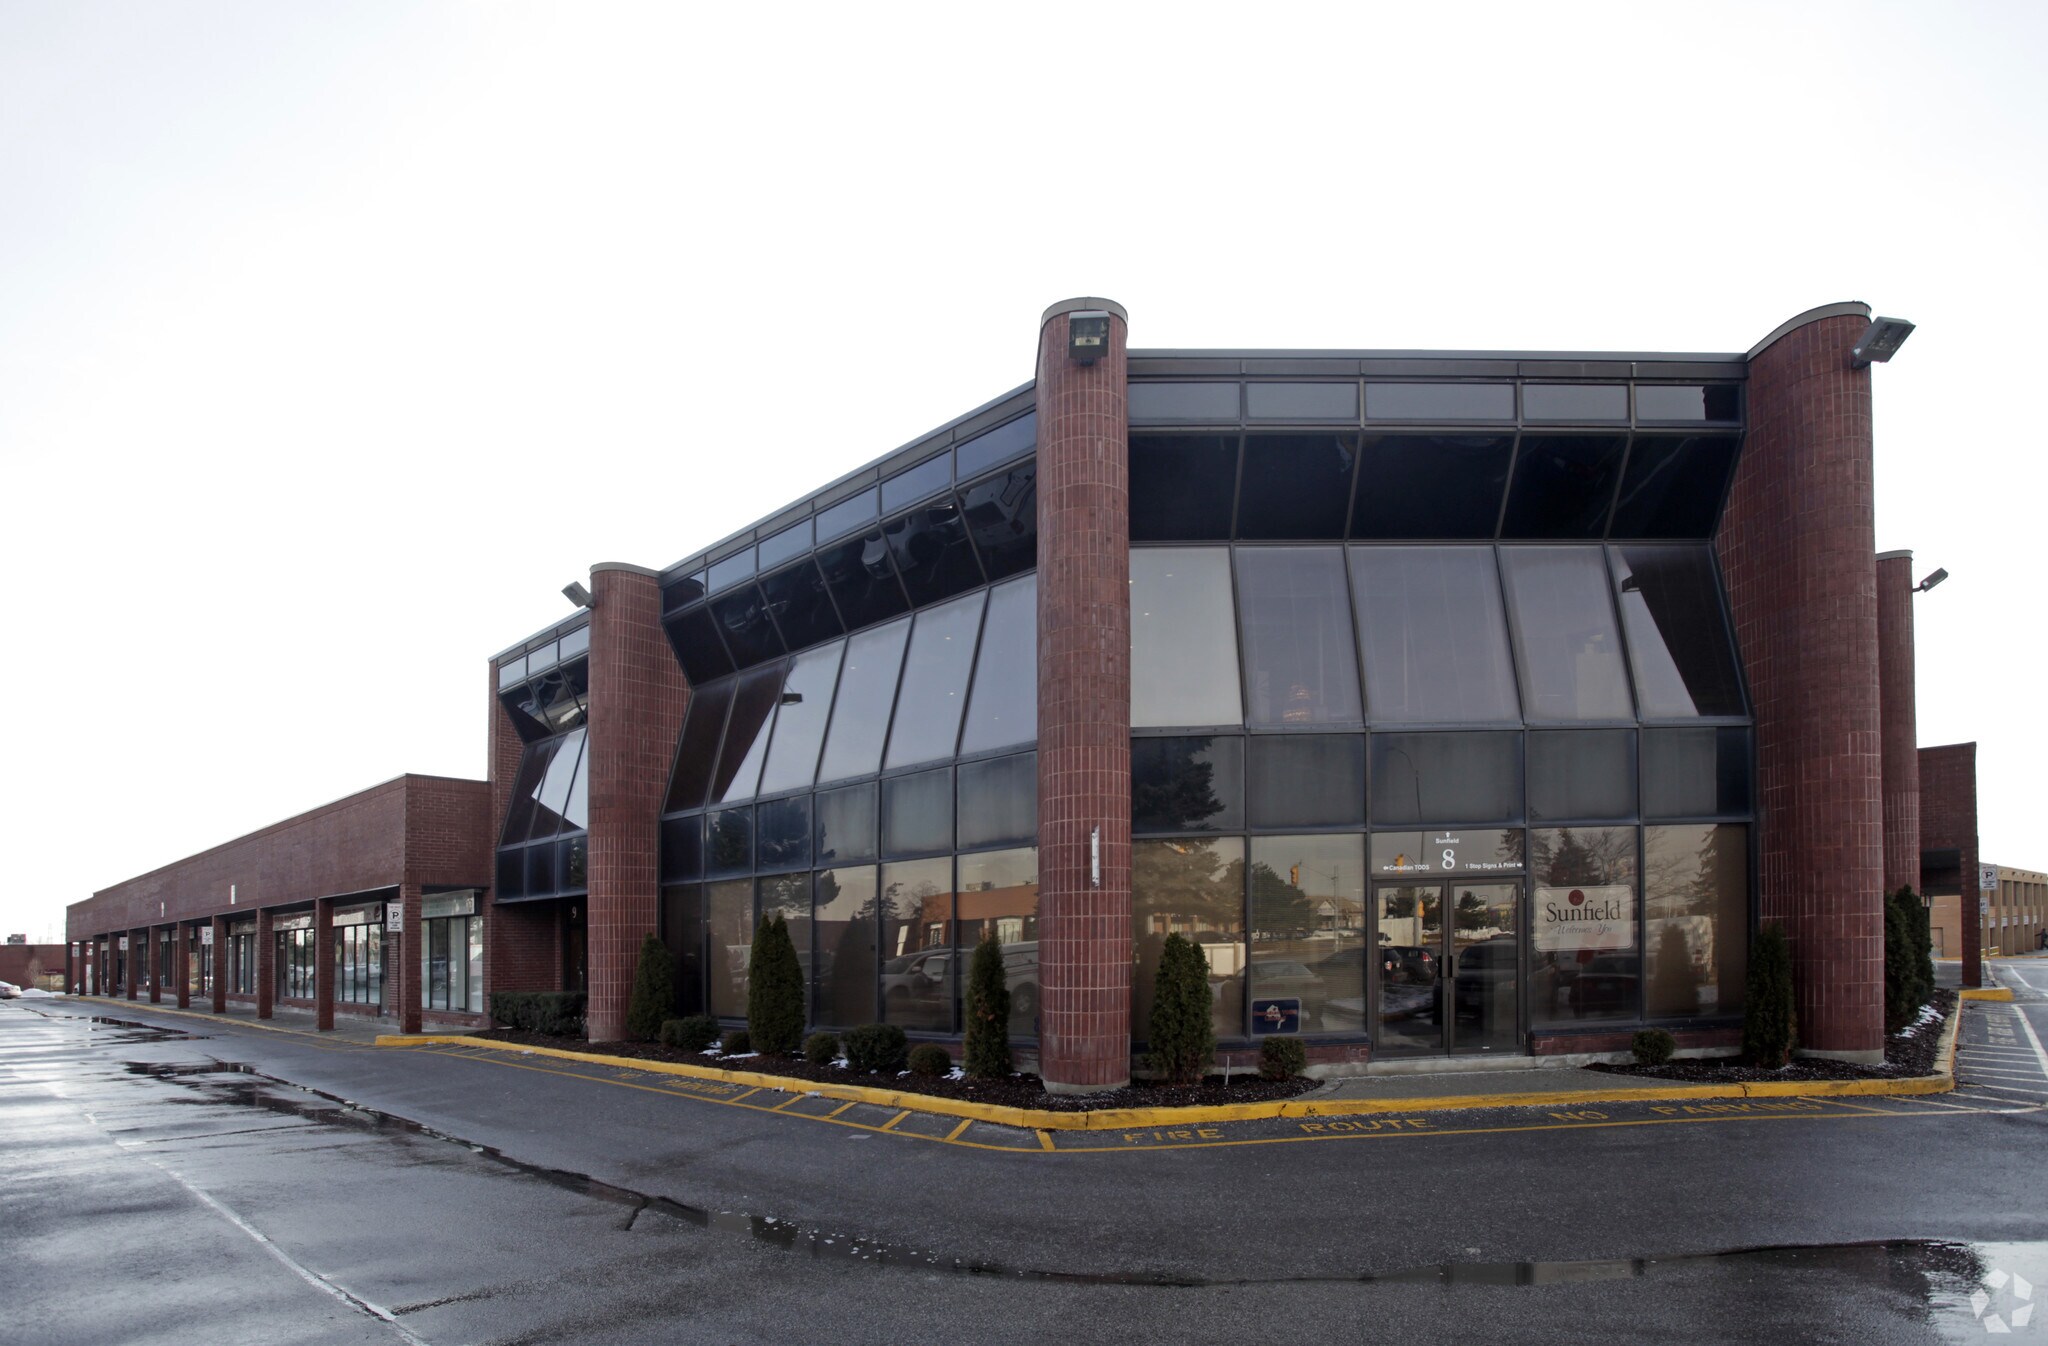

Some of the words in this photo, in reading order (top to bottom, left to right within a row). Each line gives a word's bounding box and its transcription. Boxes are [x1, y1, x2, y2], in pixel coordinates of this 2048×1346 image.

[1442, 849, 1455, 870] 8
[1482, 862, 1497, 870] Signs
[392, 911, 399, 919] P
[1546, 899, 1622, 923] Sunfield
[1552, 925, 1592, 935] Welcomes
[1596, 924, 1613, 936] You
[1548, 1110, 1609, 1121] NO
[1648, 1101, 1823, 1115] PARKING
[1122, 1128, 1225, 1142] FIRE
[1298, 1118, 1438, 1133] ROUTE
